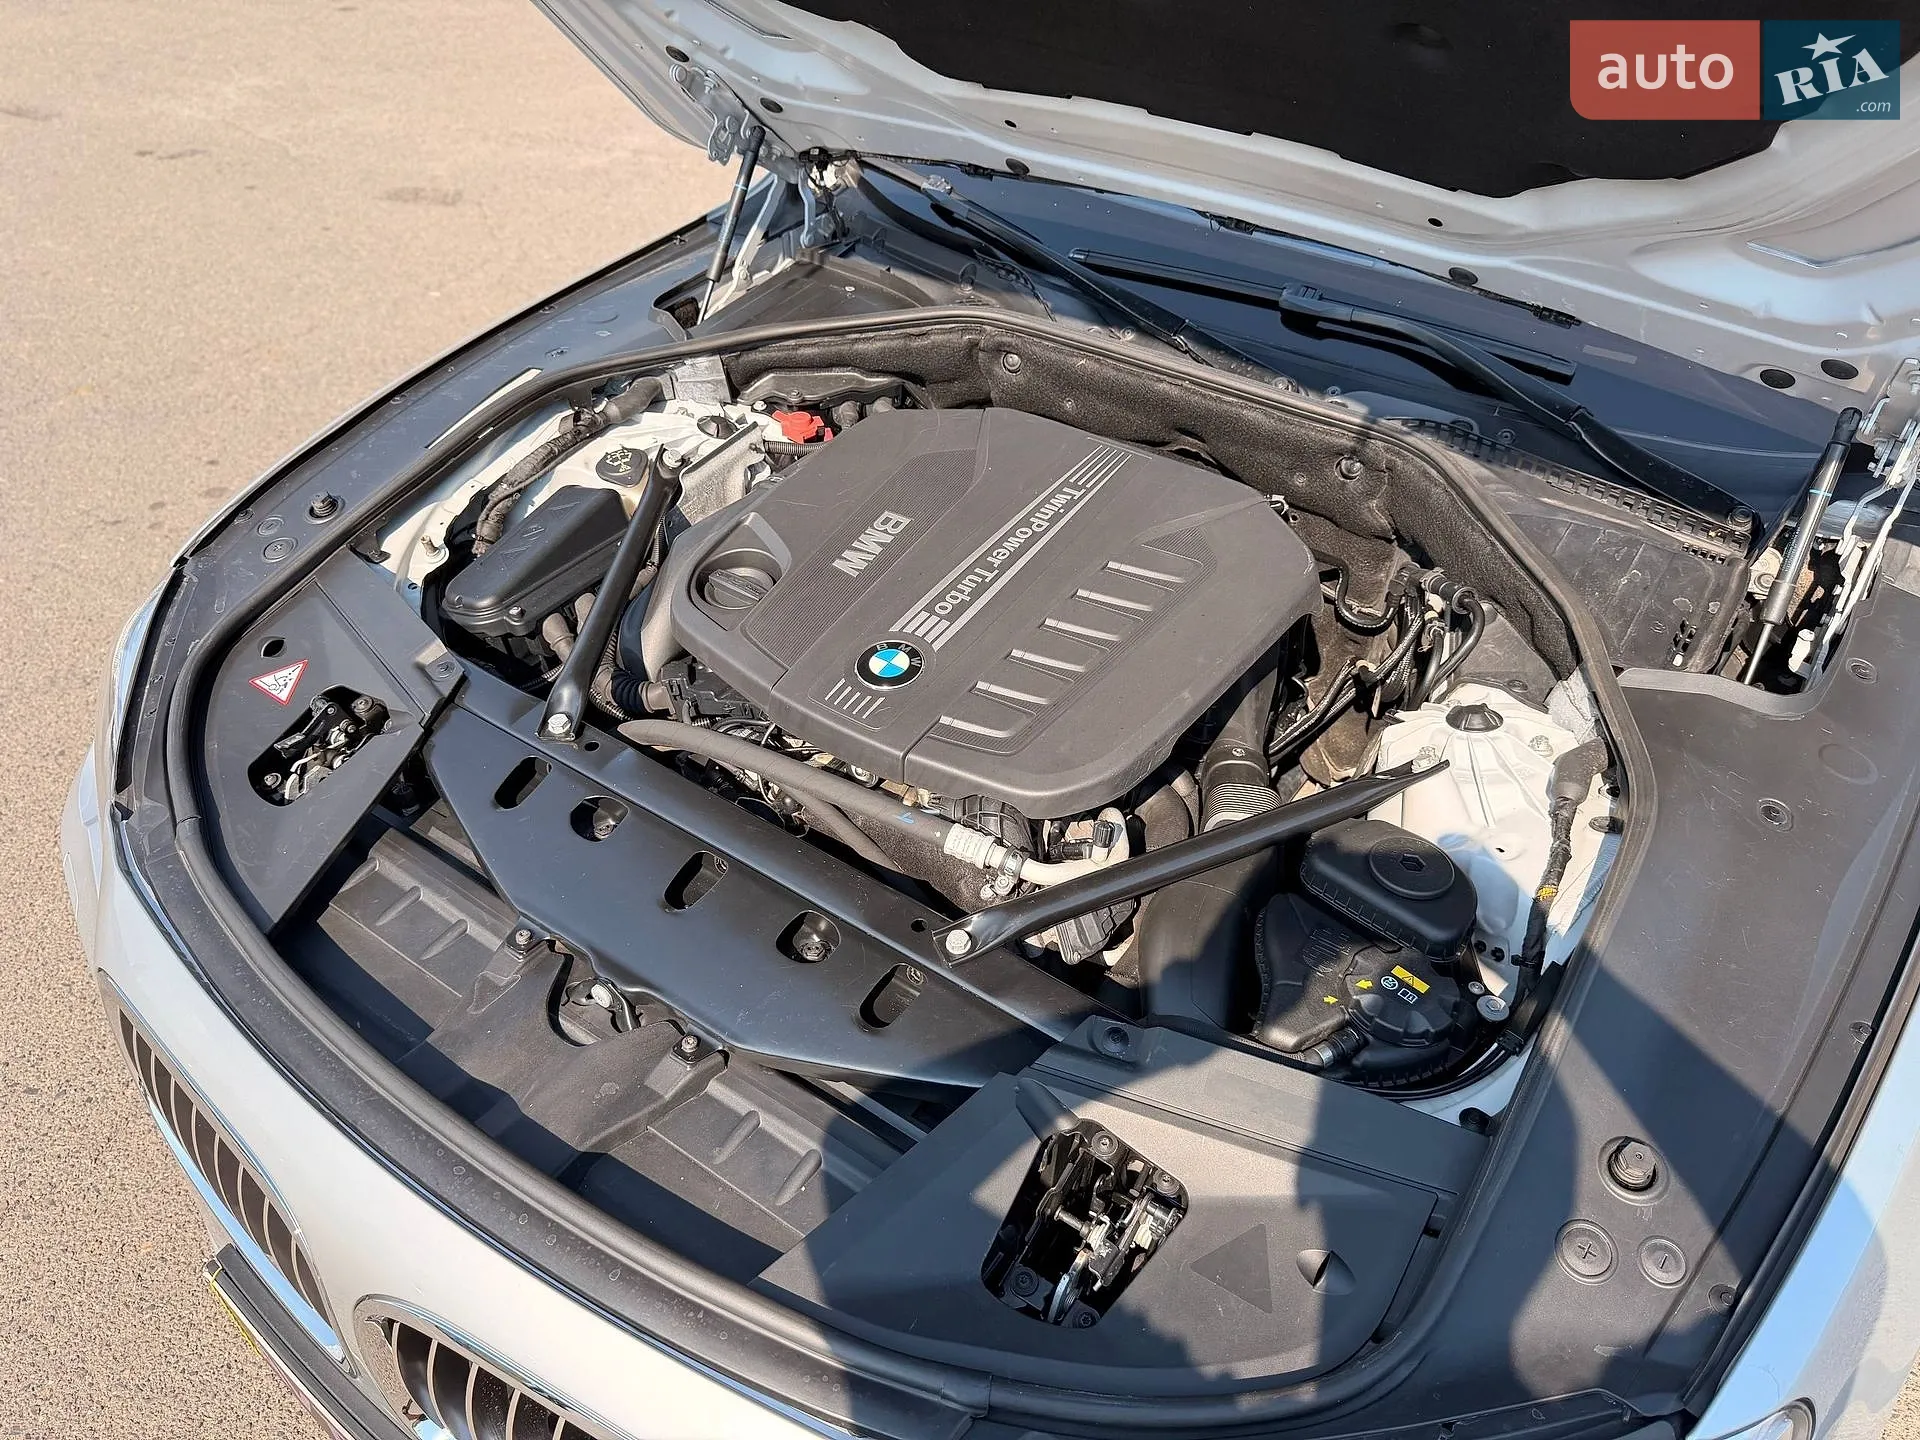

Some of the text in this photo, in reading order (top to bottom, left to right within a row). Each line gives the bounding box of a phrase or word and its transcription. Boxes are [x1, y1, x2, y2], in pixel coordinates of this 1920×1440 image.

[832, 510, 914, 578] BMW
[934, 486, 1087, 615] TwinPower Turbo
[876, 643, 922, 667] BMW
